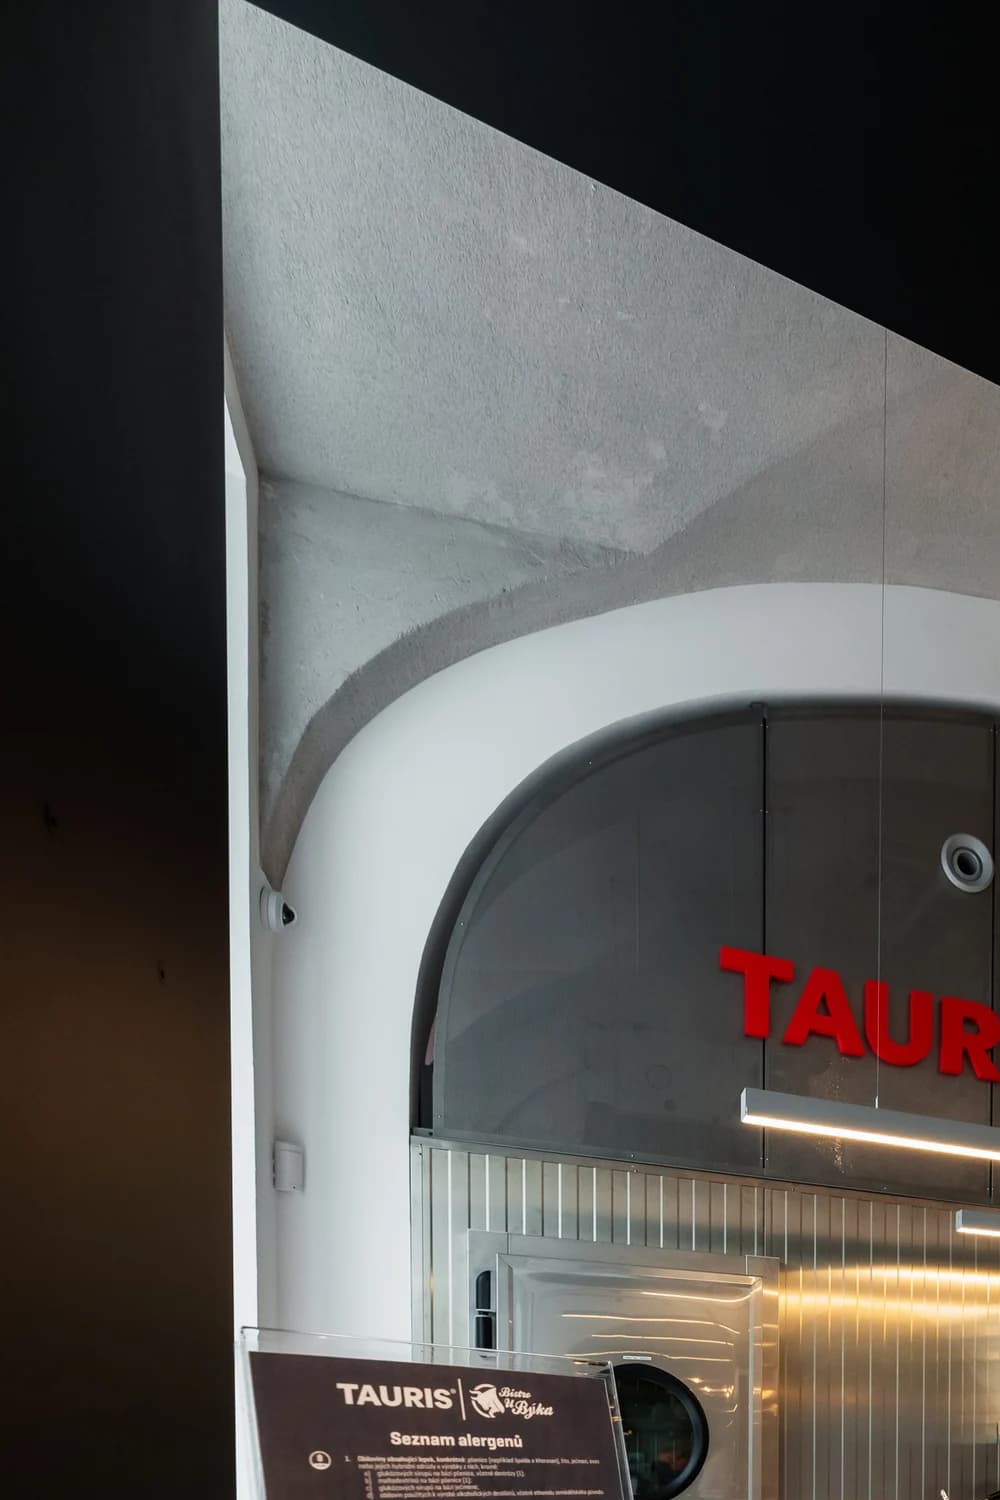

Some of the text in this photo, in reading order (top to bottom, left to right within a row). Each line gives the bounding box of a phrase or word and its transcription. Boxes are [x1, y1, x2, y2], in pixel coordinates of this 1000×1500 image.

[335, 1382, 453, 1410] TAURIS
[498, 1386, 532, 1399] Bistro
[390, 1431, 523, 1451] Seznam alergenů
